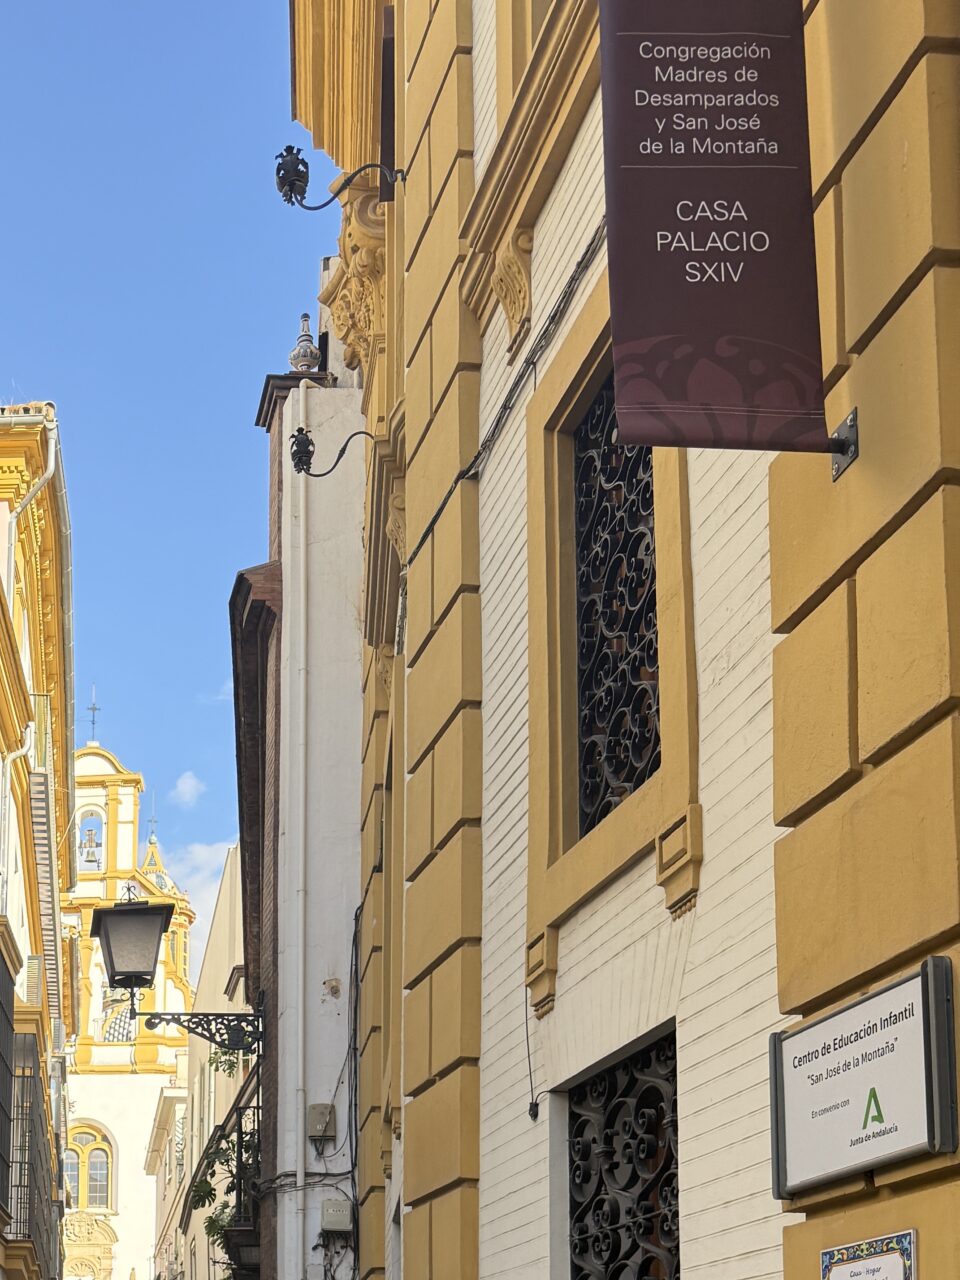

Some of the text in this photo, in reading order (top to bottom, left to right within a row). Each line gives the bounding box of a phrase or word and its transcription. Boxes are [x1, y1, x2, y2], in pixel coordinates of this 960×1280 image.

[639, 41, 771, 62] Congregación
[655, 65, 758, 82] Madres de
[635, 89, 780, 109] Desamparados
[654, 113, 761, 134] y San José
[639, 137, 778, 154] de la Montaña
[676, 200, 748, 221] CASA
[657, 231, 770, 252] PALACIO
[685, 261, 744, 282] SXIV
[792, 1002, 915, 1069] Centro de Educación Infantil
[825, 1061, 841, 1080] José
[842, 1057, 851, 1073] de
[852, 1054, 860, 1068] la
[811, 1098, 850, 1119] En convenio con
[849, 1123, 898, 1148] Junta de Andalucía
